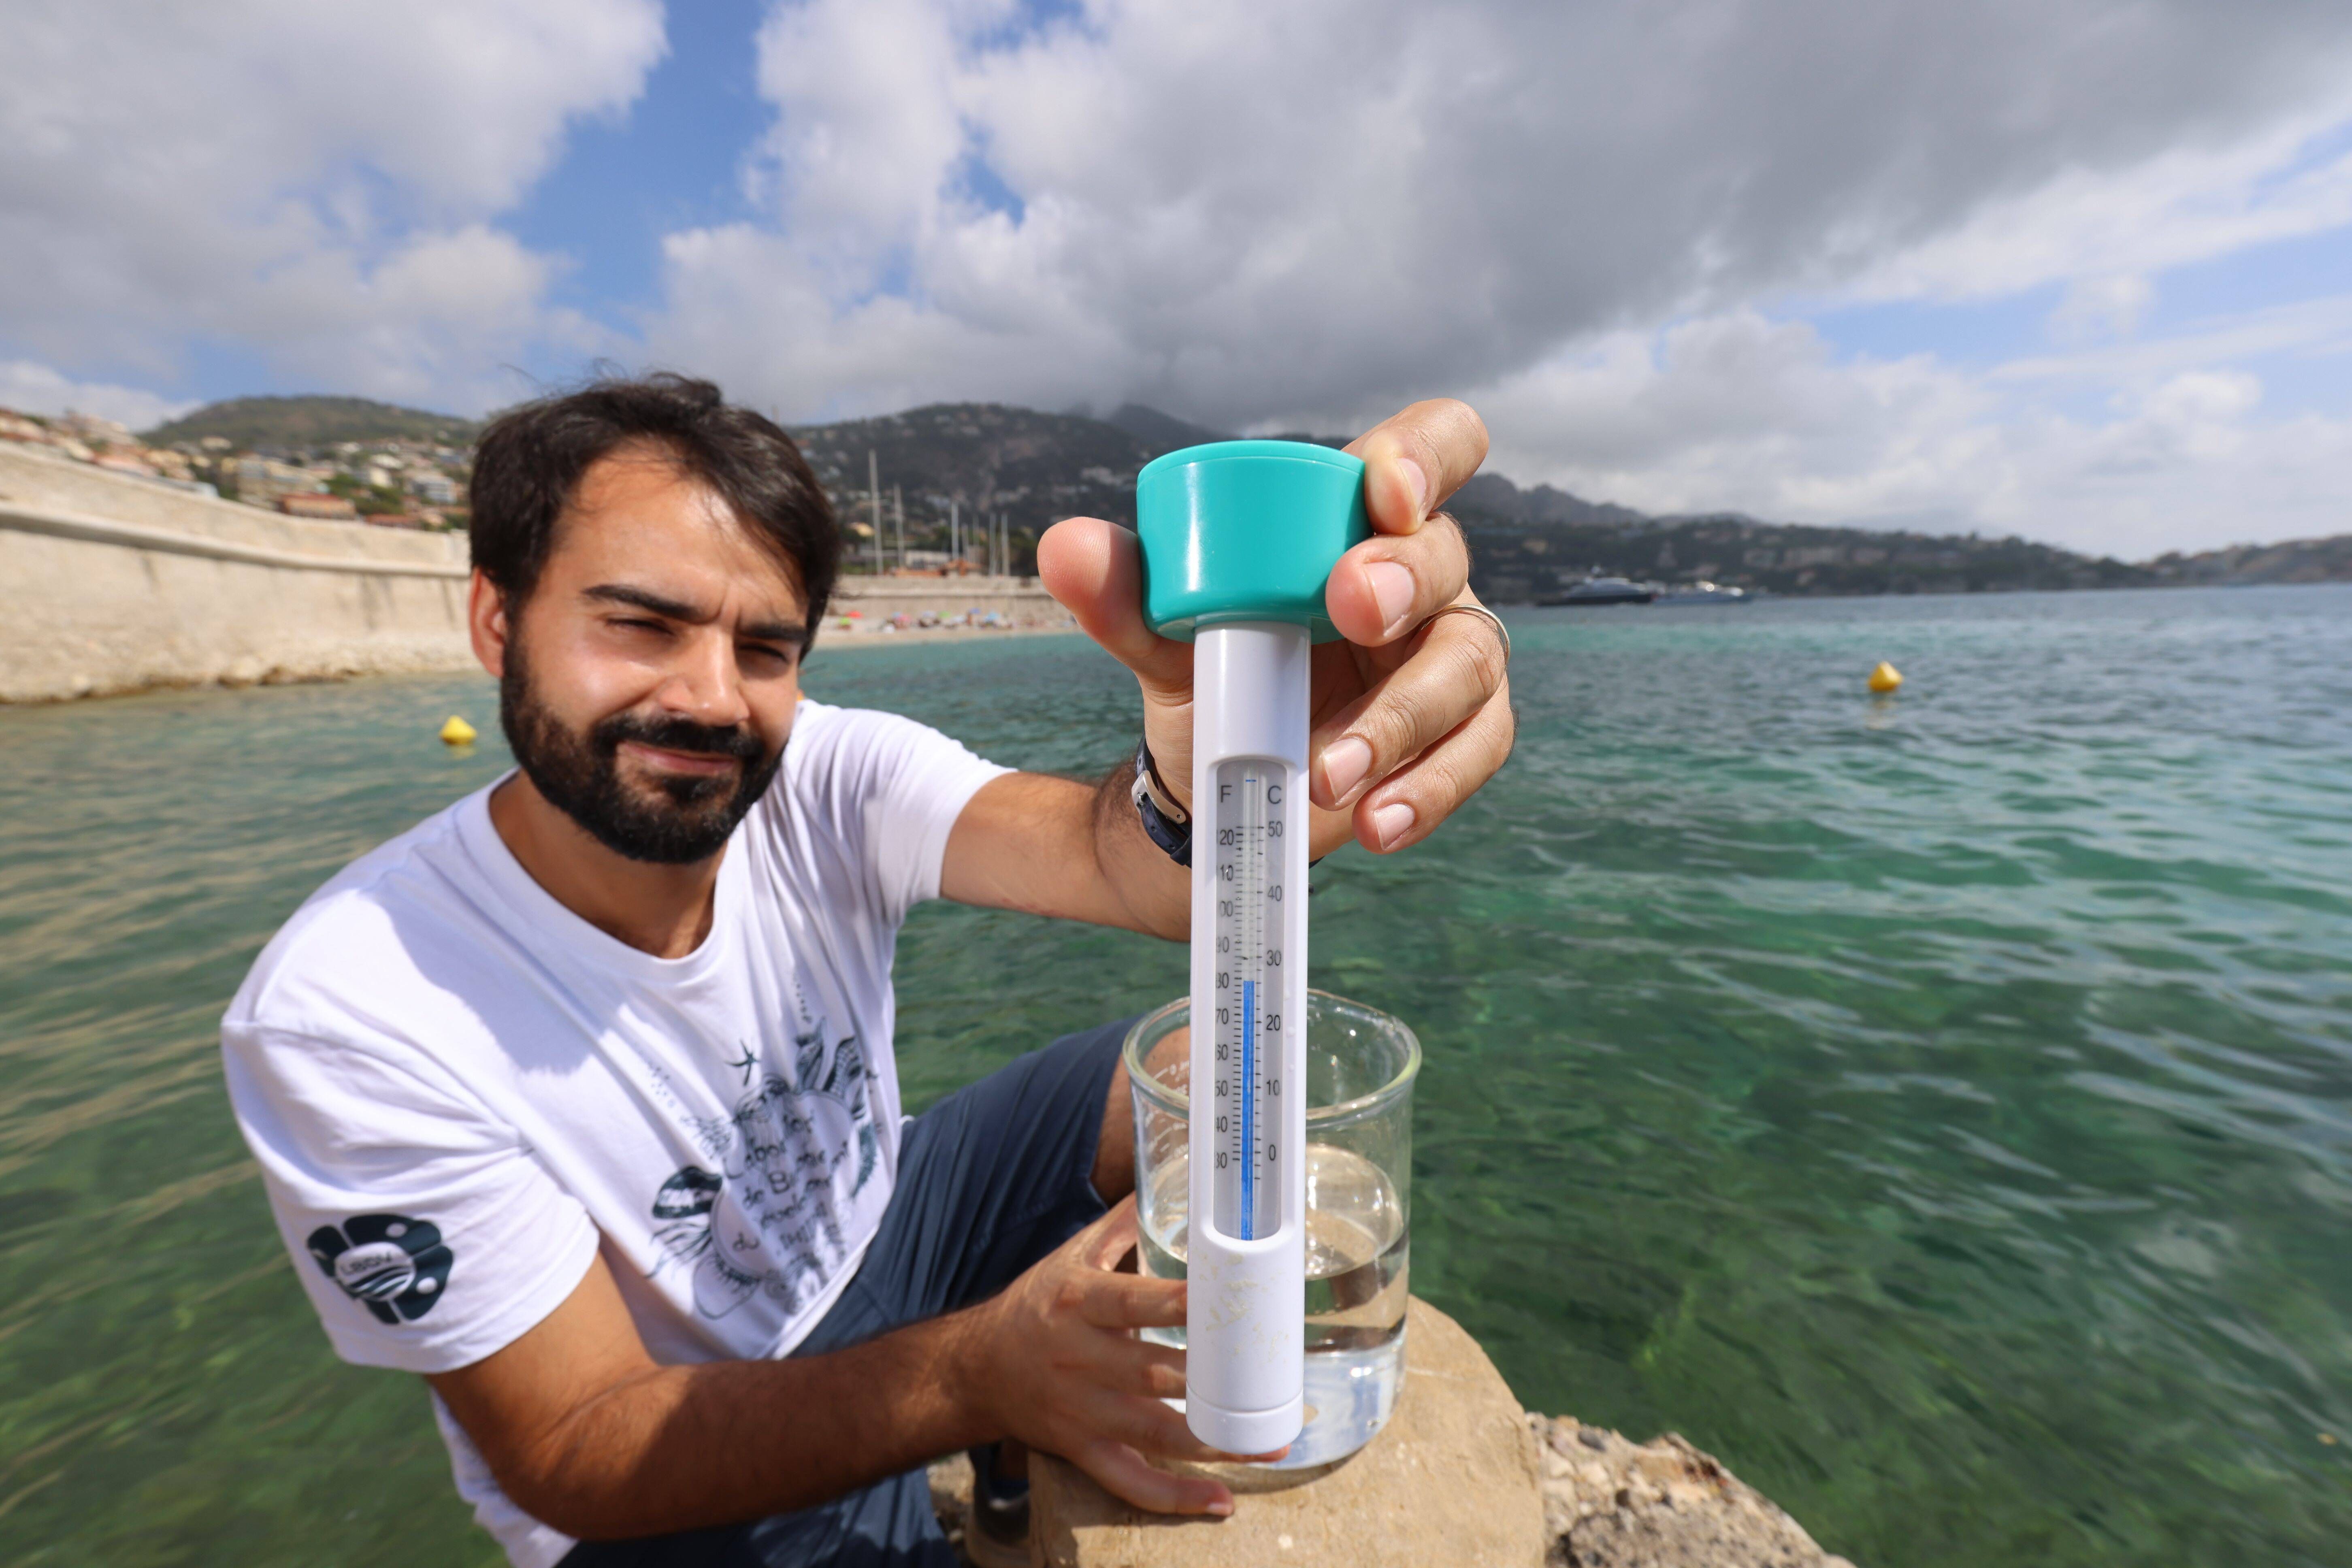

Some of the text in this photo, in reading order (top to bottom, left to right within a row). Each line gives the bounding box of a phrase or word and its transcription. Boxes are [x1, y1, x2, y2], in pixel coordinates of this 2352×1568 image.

[1221, 785, 1232, 803] F
[1268, 785, 1282, 804] C
[1268, 821, 1283, 837] 50
[1267, 885, 1282, 902] 40
[1266, 950, 1282, 966] 30
[1215, 1008, 1229, 1025] 70
[1266, 1014, 1280, 1031] 20
[1266, 1080, 1280, 1096] 10
[1268, 1144, 1276, 1161] 0
